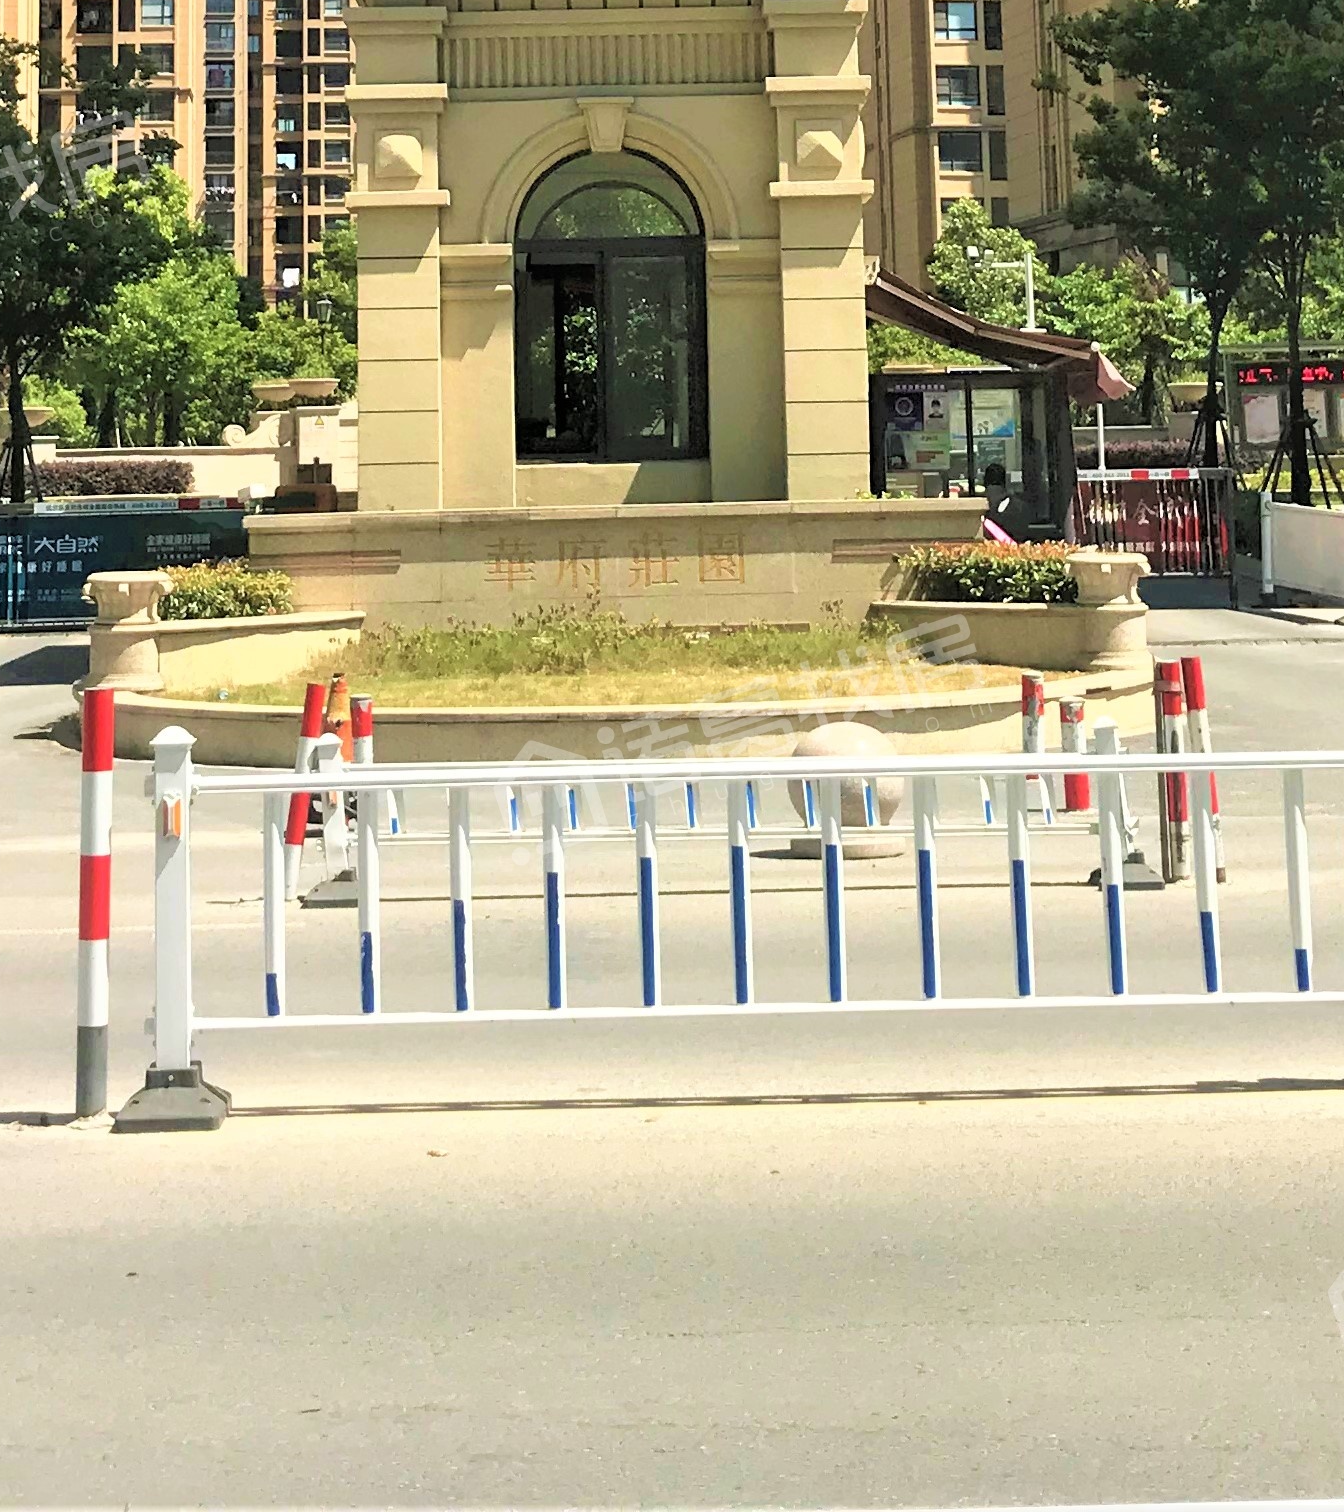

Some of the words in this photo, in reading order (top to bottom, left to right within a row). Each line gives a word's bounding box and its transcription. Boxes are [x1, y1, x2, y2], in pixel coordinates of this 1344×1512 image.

[33, 533, 99, 554] 大自然
[483, 528, 746, 592] 華府莊園
